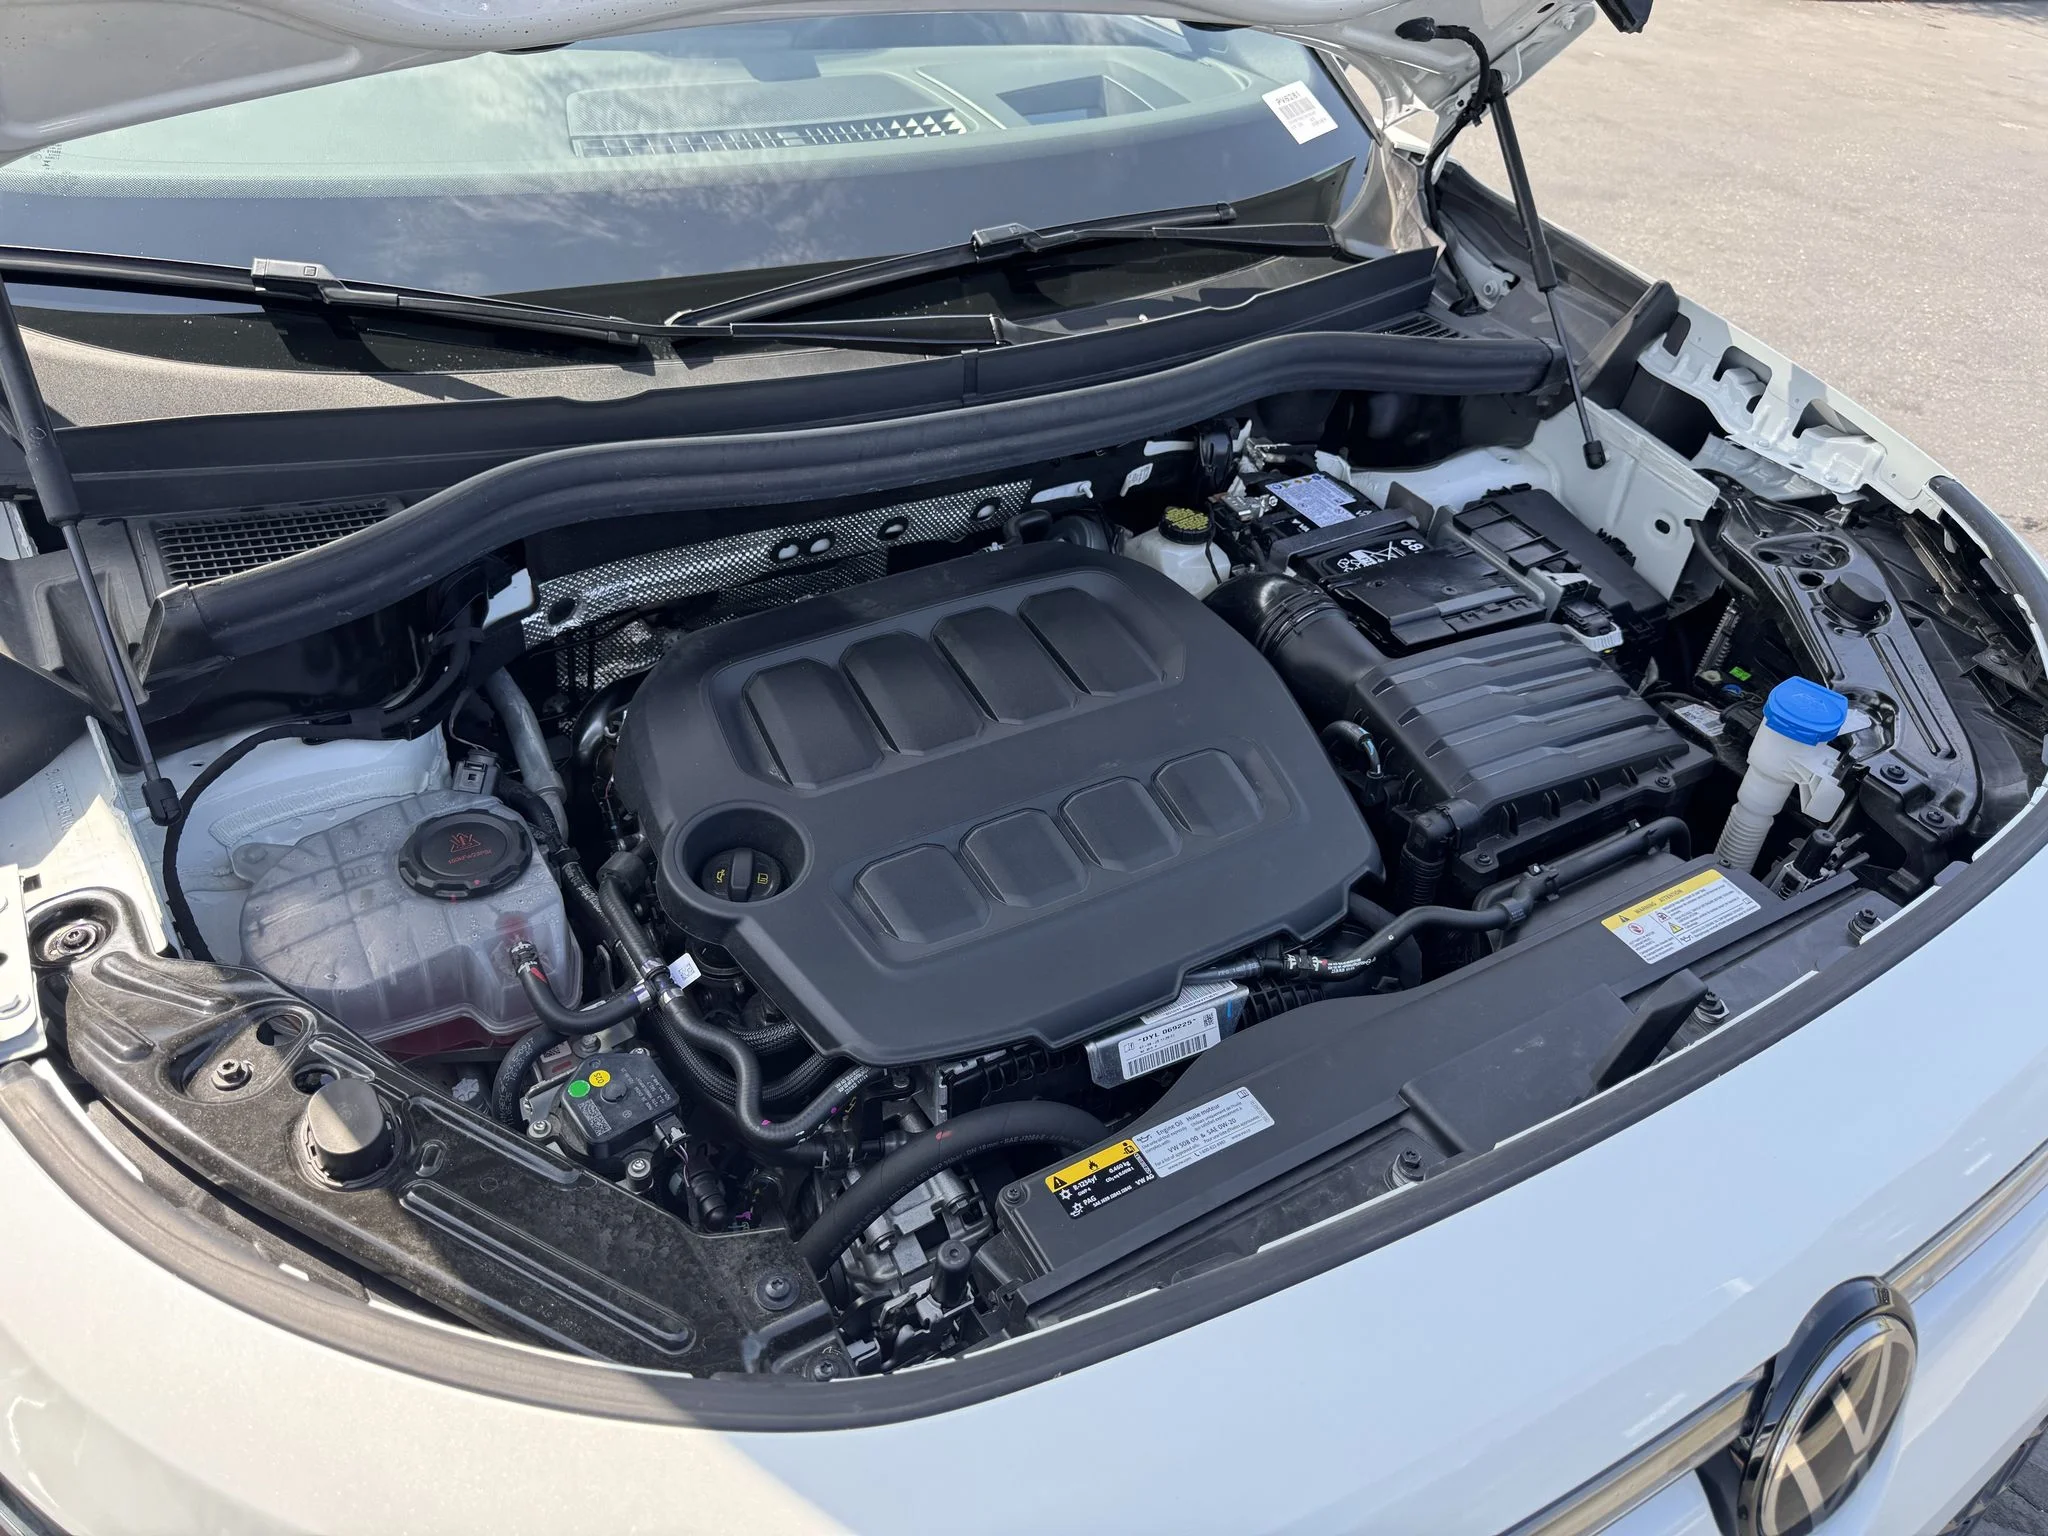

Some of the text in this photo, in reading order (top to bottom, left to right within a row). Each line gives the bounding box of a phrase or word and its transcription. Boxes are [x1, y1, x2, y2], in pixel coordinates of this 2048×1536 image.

[1401, 540, 1424, 553] 68
[1185, 1104, 1219, 1121] Huile moteur
[1155, 1119, 1183, 1135] Engine Oil
[1167, 1144, 1179, 1153] VW
[1178, 1139, 1191, 1148] 508
[1206, 1126, 1218, 1135] SAE
[1217, 1118, 1236, 1129] 0W-20
[1072, 1175, 1097, 1190] R-1234yf
[1134, 1173, 1154, 1185] VW AG
[1082, 1195, 1097, 1205] PAG
